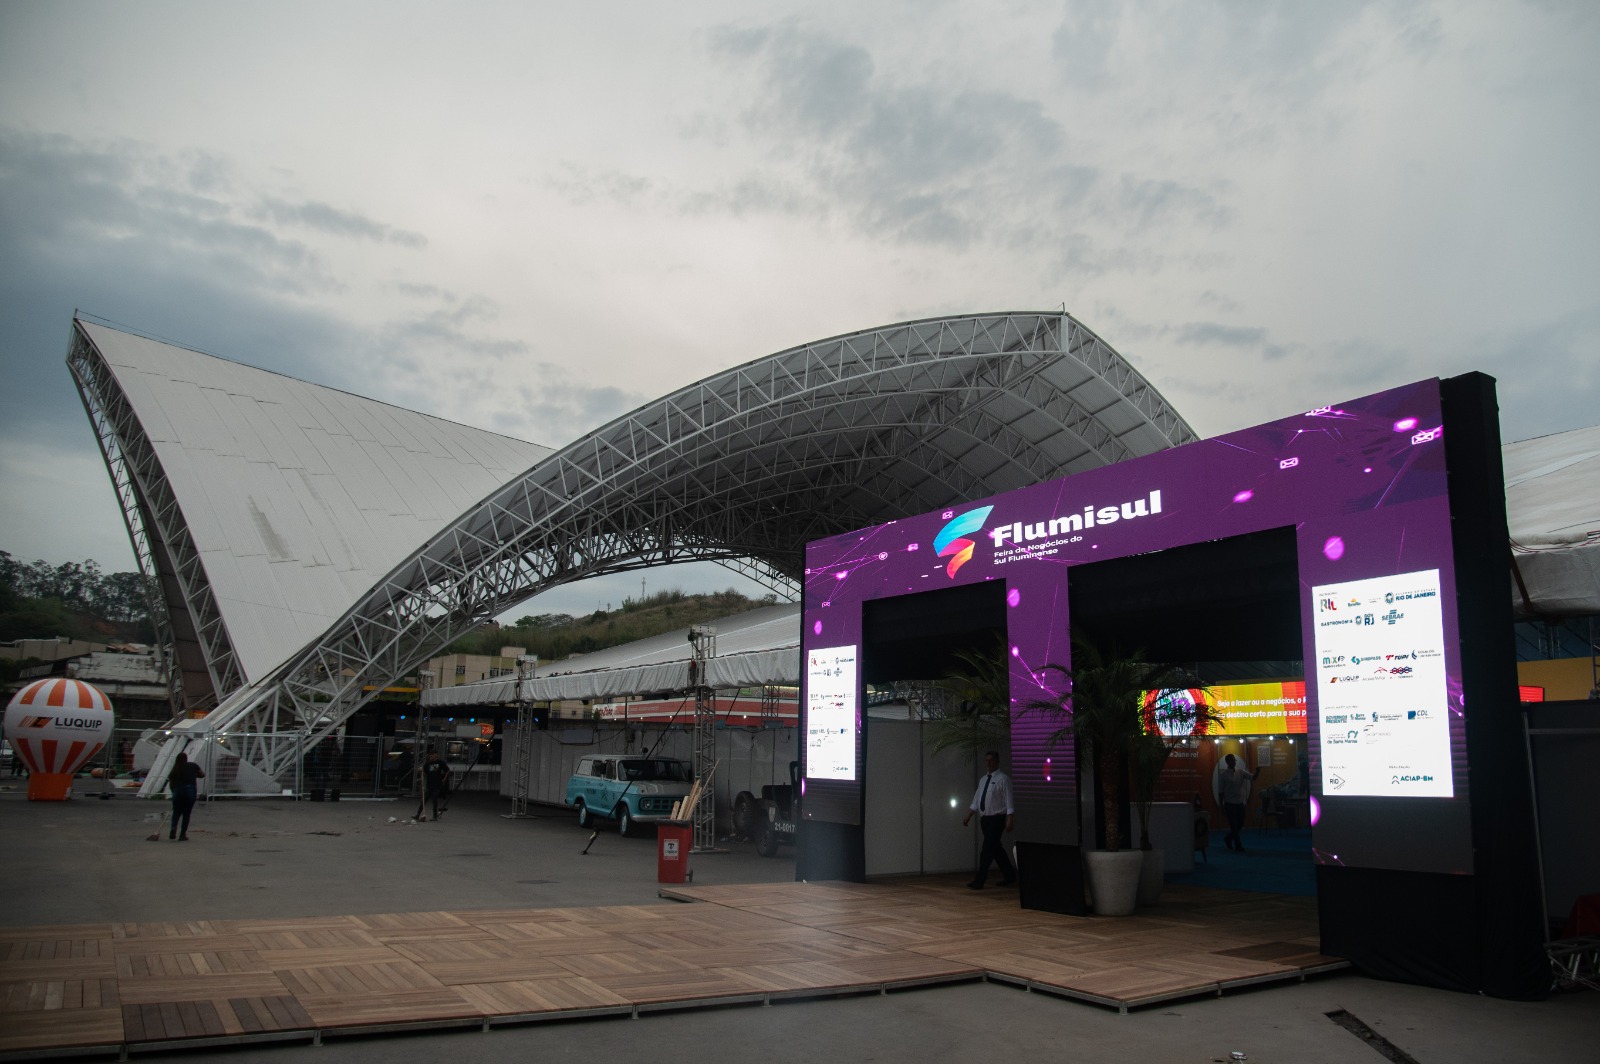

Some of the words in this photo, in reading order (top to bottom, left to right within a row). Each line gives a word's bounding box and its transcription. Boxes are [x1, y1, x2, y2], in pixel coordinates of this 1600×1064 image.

[994, 490, 1162, 547] Flumisul
[994, 549, 1013, 557] Feira
[1014, 547, 1026, 555] de
[1027, 539, 1069, 551] Negócios
[1070, 535, 1083, 543] do
[1008, 548, 1059, 562] Fluminense
[1413, 591, 1436, 599] JANEIRO
[1217, 699, 1230, 708] Seja
[1265, 697, 1296, 706] negócios,
[1226, 710, 1249, 718] destino
[1249, 710, 1266, 718] certo
[1267, 711, 1282, 719] para
[55, 717, 102, 728] LUQUIP
